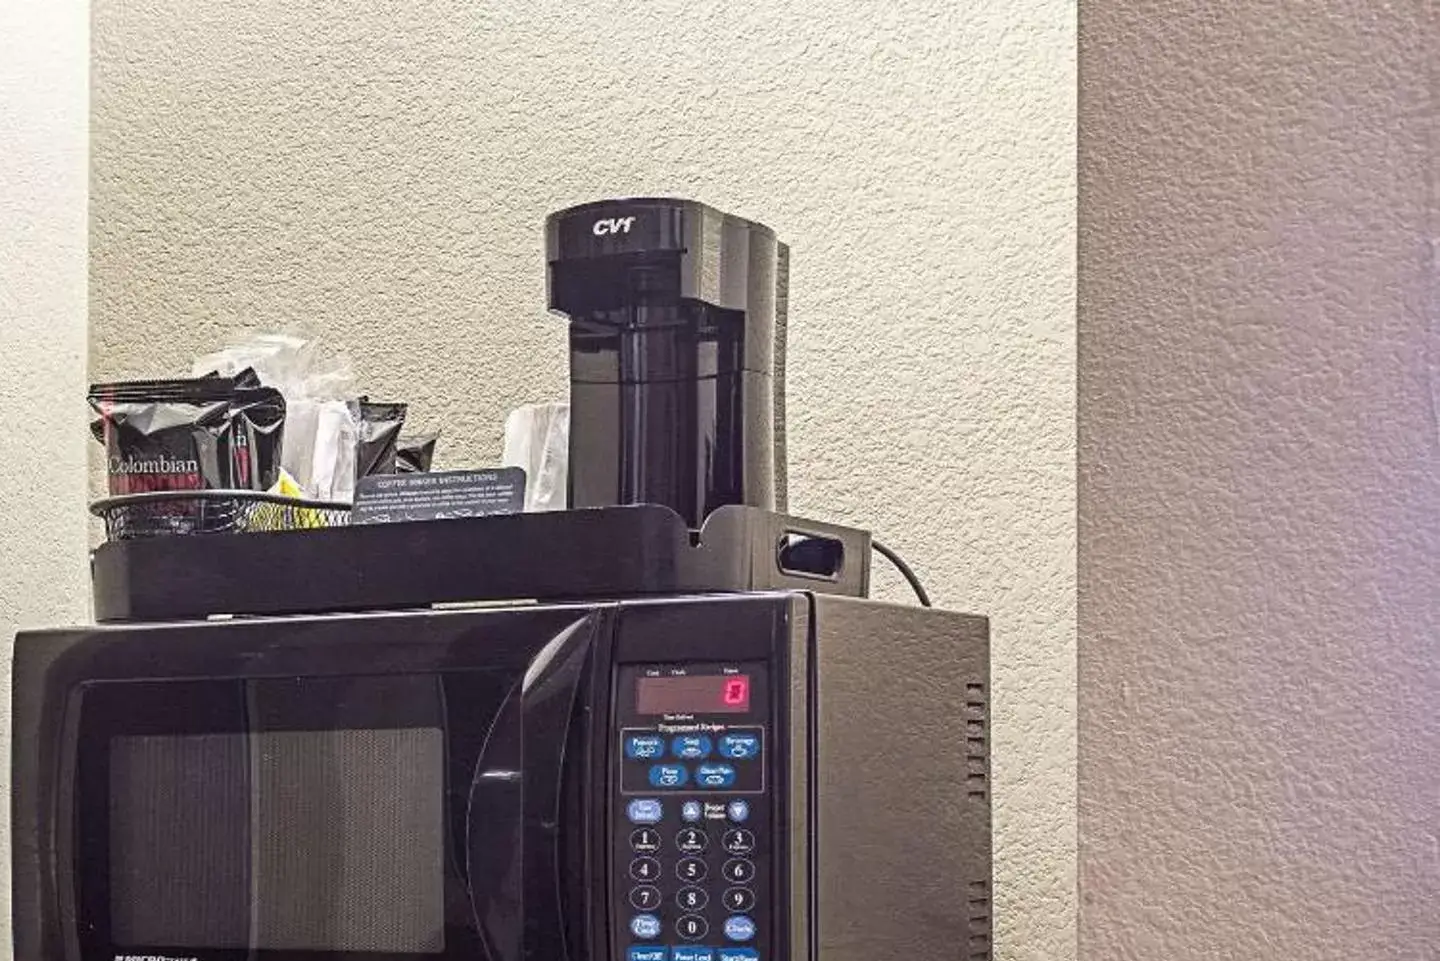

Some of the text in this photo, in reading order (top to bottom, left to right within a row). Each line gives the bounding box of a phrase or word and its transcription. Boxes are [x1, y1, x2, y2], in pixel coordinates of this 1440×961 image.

[109, 454, 199, 474] Colombian
[642, 831, 648, 844] 1
[688, 831, 696, 844] 2
[734, 831, 743, 845] 3
[640, 864, 648, 876] 4
[687, 864, 696, 876] 5
[734, 864, 743, 877] 6
[641, 892, 649, 904] 7
[688, 892, 696, 905] 8
[734, 892, 743, 905] 9
[688, 921, 696, 933] 0
